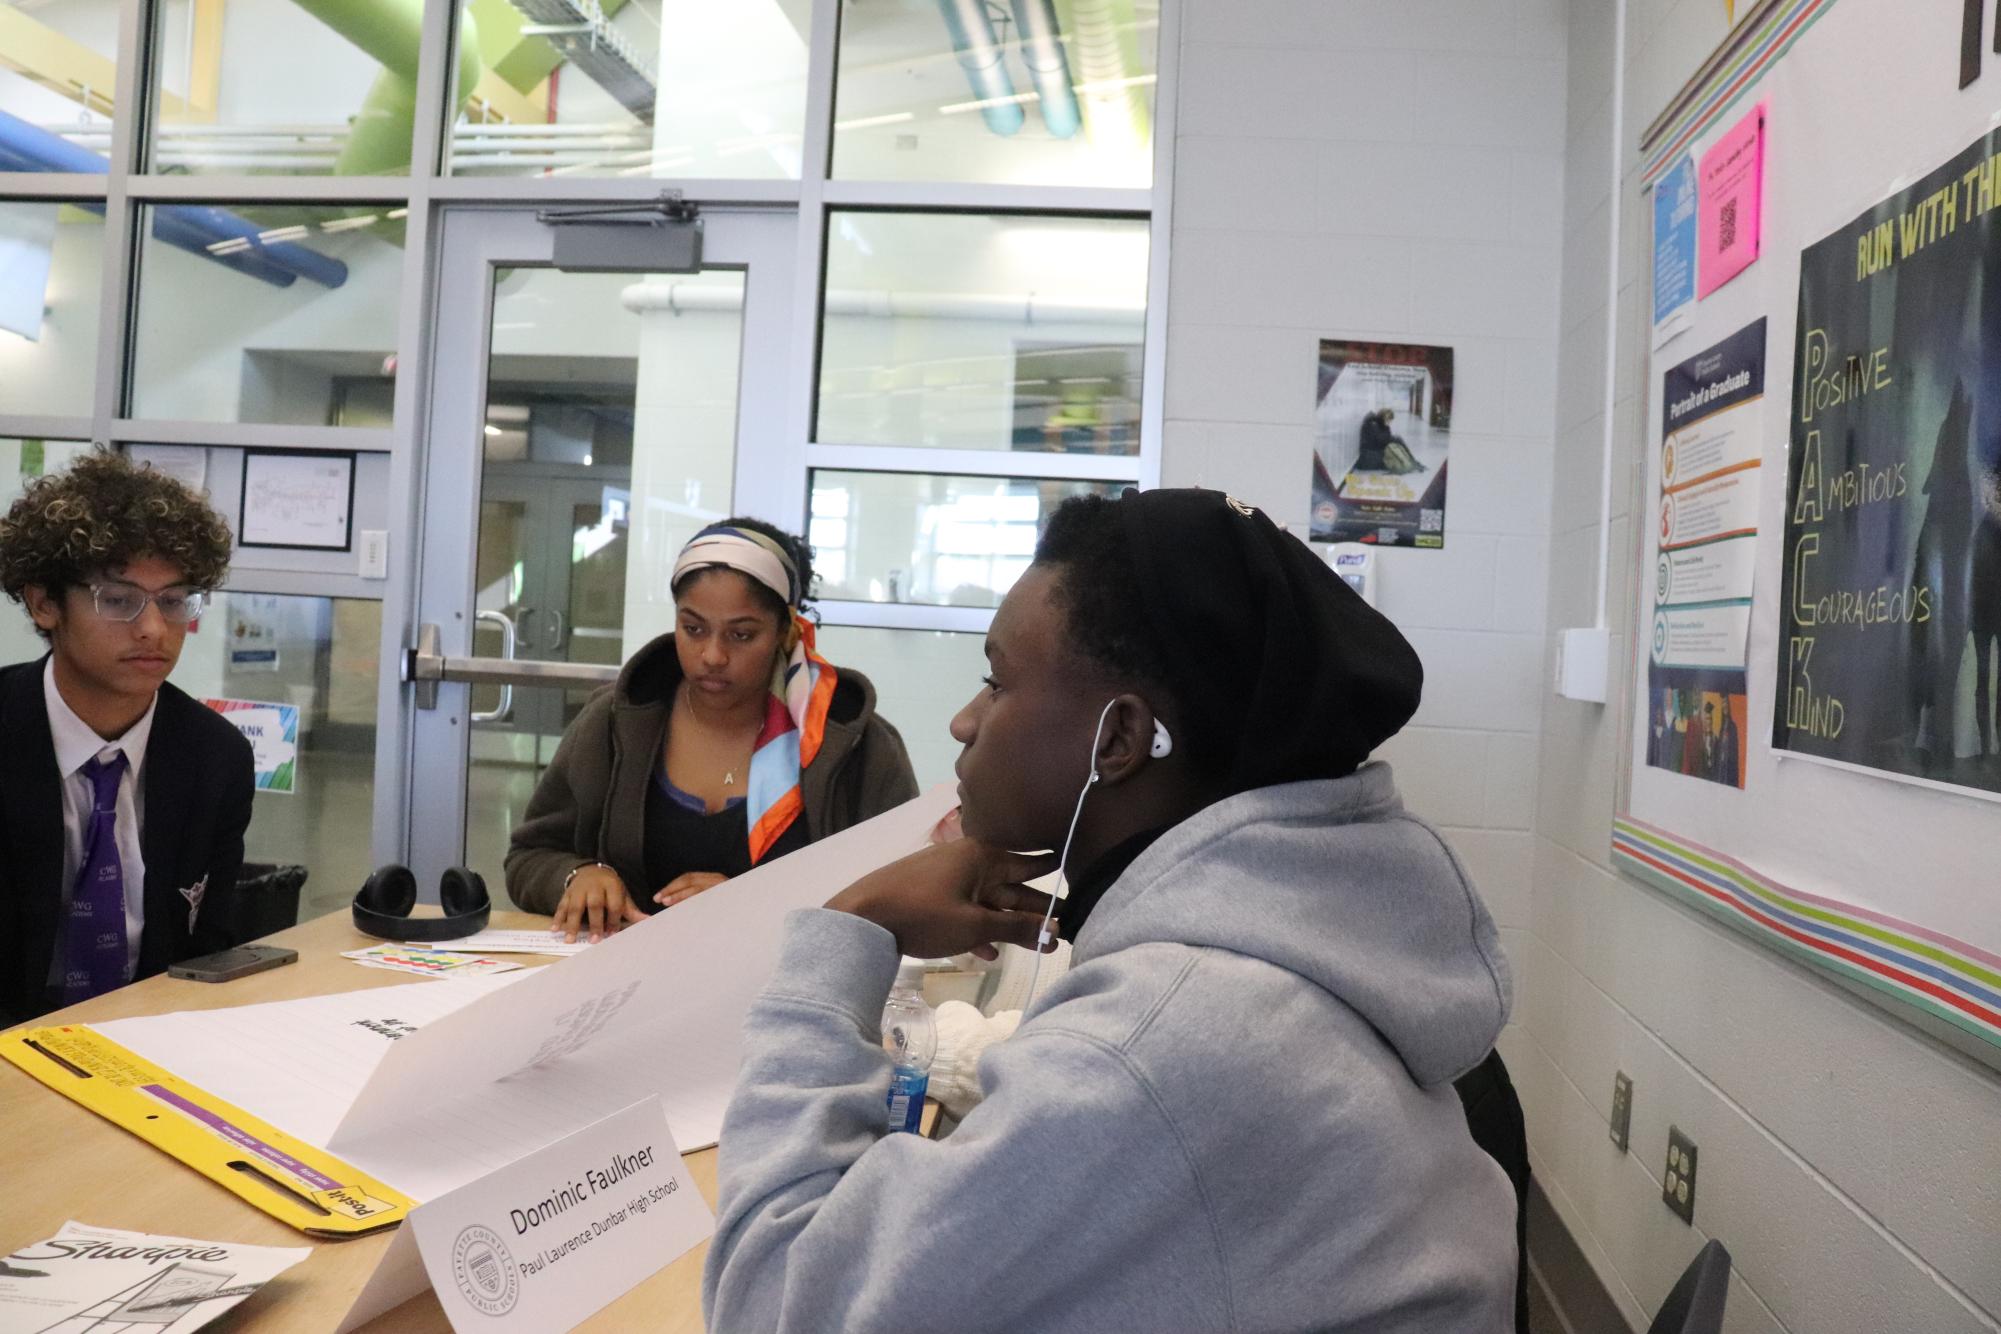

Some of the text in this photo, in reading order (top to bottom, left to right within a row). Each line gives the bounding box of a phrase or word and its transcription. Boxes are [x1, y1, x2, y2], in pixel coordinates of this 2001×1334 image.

[1857, 219, 1894, 283] RUN
[1900, 180, 1959, 259] WITH
[1670, 391, 1696, 420] Portrait
[1696, 386, 1705, 407] of
[1710, 370, 1750, 399] Graduate
[1794, 430, 1906, 524] AMBITIOUS
[1793, 533, 1930, 631] COURAGEOUS
[1787, 637, 1844, 738] KIND
[239, 725, 264, 736] ANK
[724, 773, 734, 785] A
[328, 1189, 375, 1217] Post-it
[510, 1146, 654, 1235] Dominic Faulkner
[519, 1176, 679, 1278] Paul Laurence Dunbar High School
[9, 1240, 229, 1265] Sharpie
[455, 1229, 505, 1279] FAYETTE COUNTY
[465, 1265, 516, 1312] PUBLIC SCHOOLS
